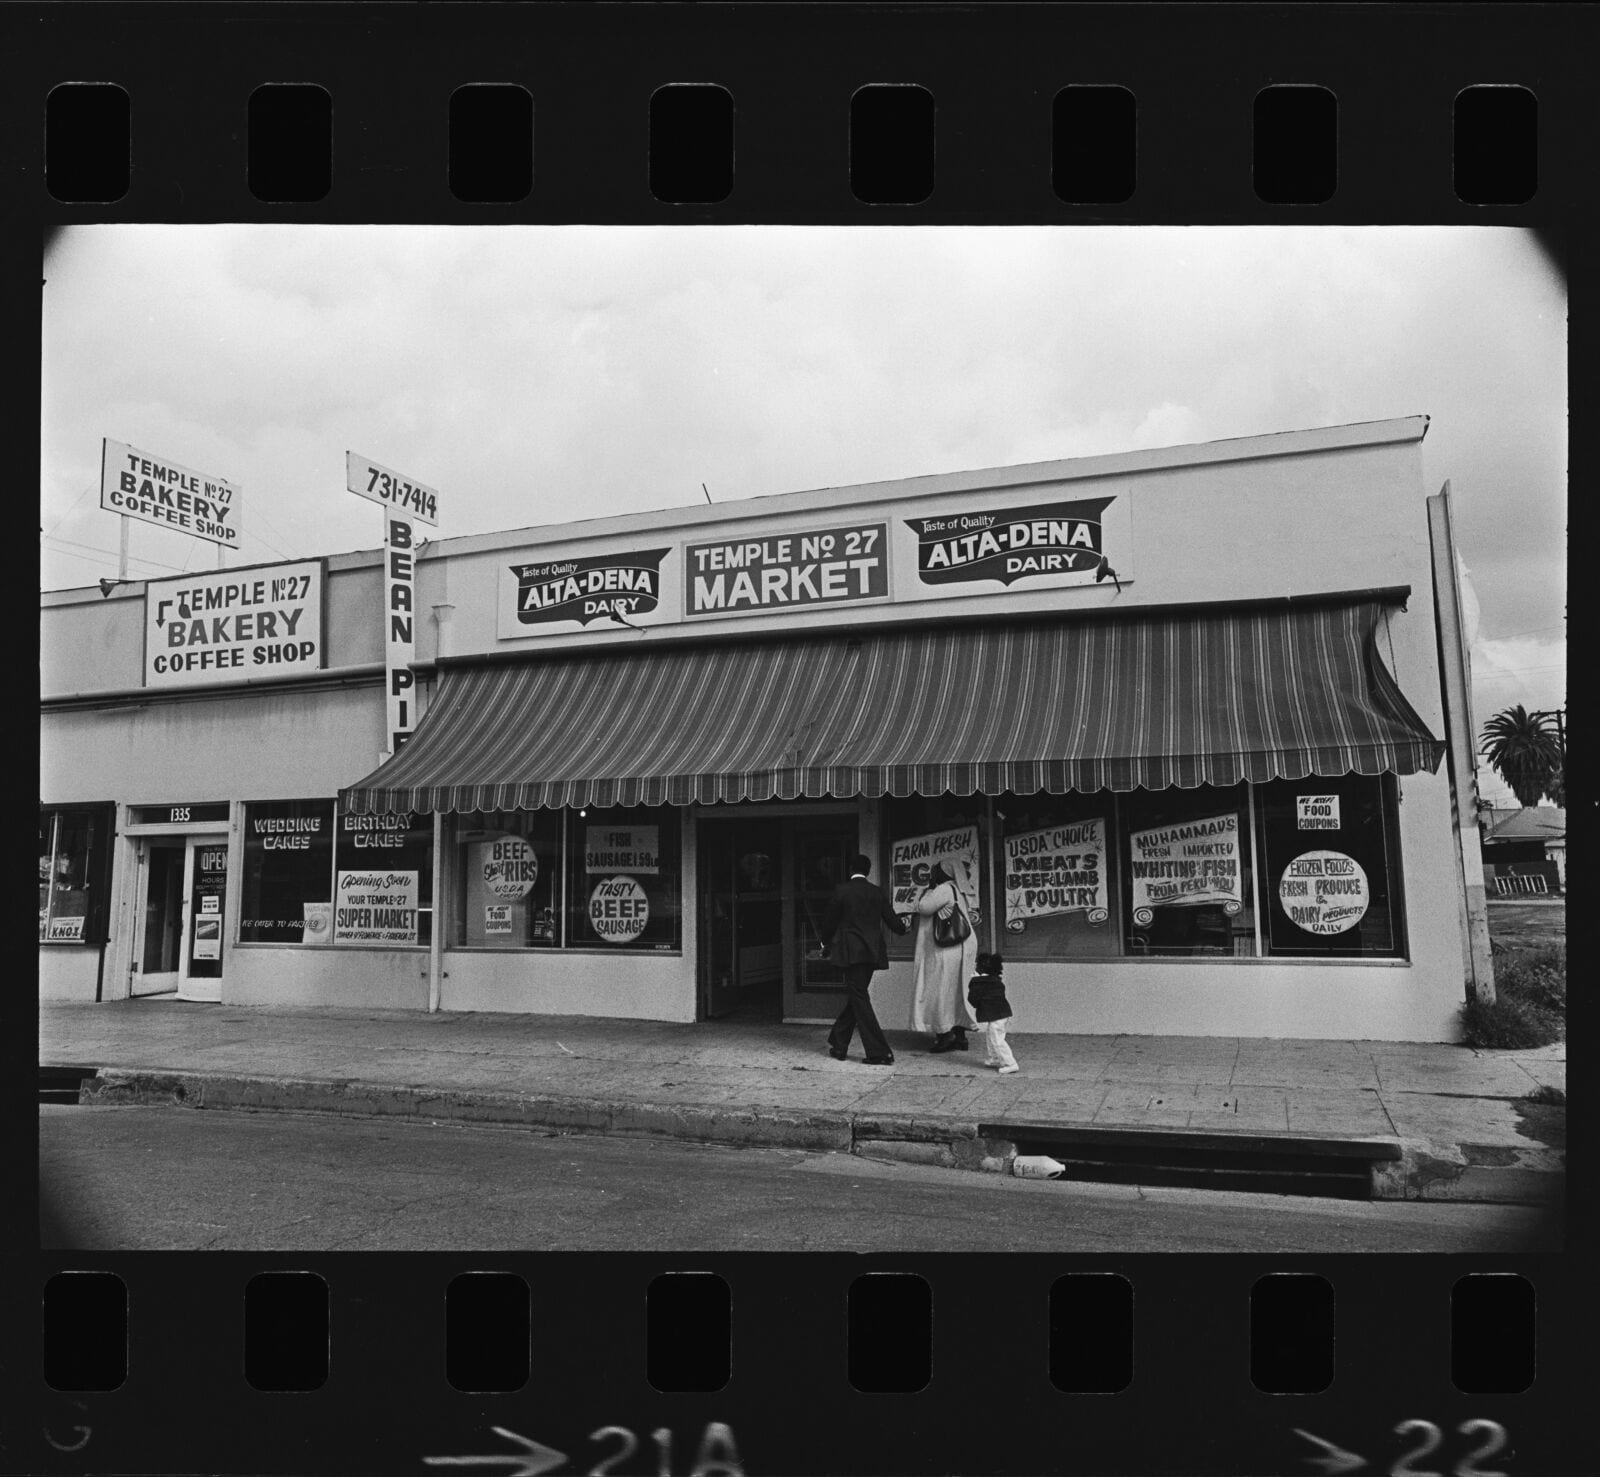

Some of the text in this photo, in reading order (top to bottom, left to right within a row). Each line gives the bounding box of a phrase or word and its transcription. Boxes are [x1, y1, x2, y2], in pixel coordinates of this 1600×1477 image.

[128, 454, 199, 493] TEMPLE
[218, 486, 233, 504] 27
[120, 470, 230, 524] BAKERY
[367, 467, 437, 519] 731-7414
[110, 491, 236, 540] COFFEE SHOP
[922, 515, 995, 533] Taste of Quality
[694, 539, 792, 571] TEMPLE
[844, 529, 879, 556] 27
[927, 521, 1093, 568] ALTA-DENA
[521, 563, 578, 579] Taste of Quality
[1006, 552, 1078, 574] DAIRY
[390, 519, 412, 643] BEAN
[523, 569, 652, 611] ALTA-DENA
[694, 557, 879, 611] MARKET
[177, 581, 265, 612] TEMPLE
[288, 576, 311, 600] 27
[584, 597, 640, 615] DAIRY
[168, 608, 304, 648] BAKERY
[154, 641, 315, 674] COFFEE SHOP
[170, 808, 191, 822] 1335
[1304, 805, 1332, 816] FOOD
[254, 817, 321, 832] WEDDING
[344, 814, 413, 831] BIRTHDAY
[1299, 818, 1339, 828] COUPONS
[354, 833, 405, 848] CAKES
[609, 832, 632, 847] FISH
[1053, 823, 1097, 849] CHOICE
[1137, 817, 1235, 850] MUHAMMAD'S
[263, 836, 311, 850] CAKES
[493, 842, 528, 860] BEEF
[895, 829, 972, 863] FARM FRESH
[1143, 843, 1233, 859] FRESH IMPORTED
[202, 852, 227, 870] OPEN
[586, 852, 633, 867] SAUSAGE
[1013, 853, 1098, 872] MEATS
[1133, 859, 1237, 878] WHITING FISH
[1290, 859, 1354, 876] FROZEN FOODS
[504, 860, 536, 882] RIBS
[341, 874, 411, 892] Opening Soon
[494, 884, 524, 893] USDA
[599, 883, 637, 897] TASTY
[1145, 883, 1178, 898] FROM
[1281, 879, 1361, 897] FRESH PRODUCE
[348, 895, 365, 905] YOUR
[367, 895, 393, 905] TEMPLE
[894, 887, 918, 903] WE
[1025, 887, 1099, 908] POULTRY
[592, 899, 647, 918] BEEF
[1291, 906, 1364, 924] DAIRY PRODUCTS
[337, 908, 416, 929] SUPER MARKET
[596, 919, 645, 935] SAUSAGE
[1312, 924, 1342, 932] DAILY
[588, 1421, 745, 1477] 21A
[1389, 1418, 1508, 1477] 22
